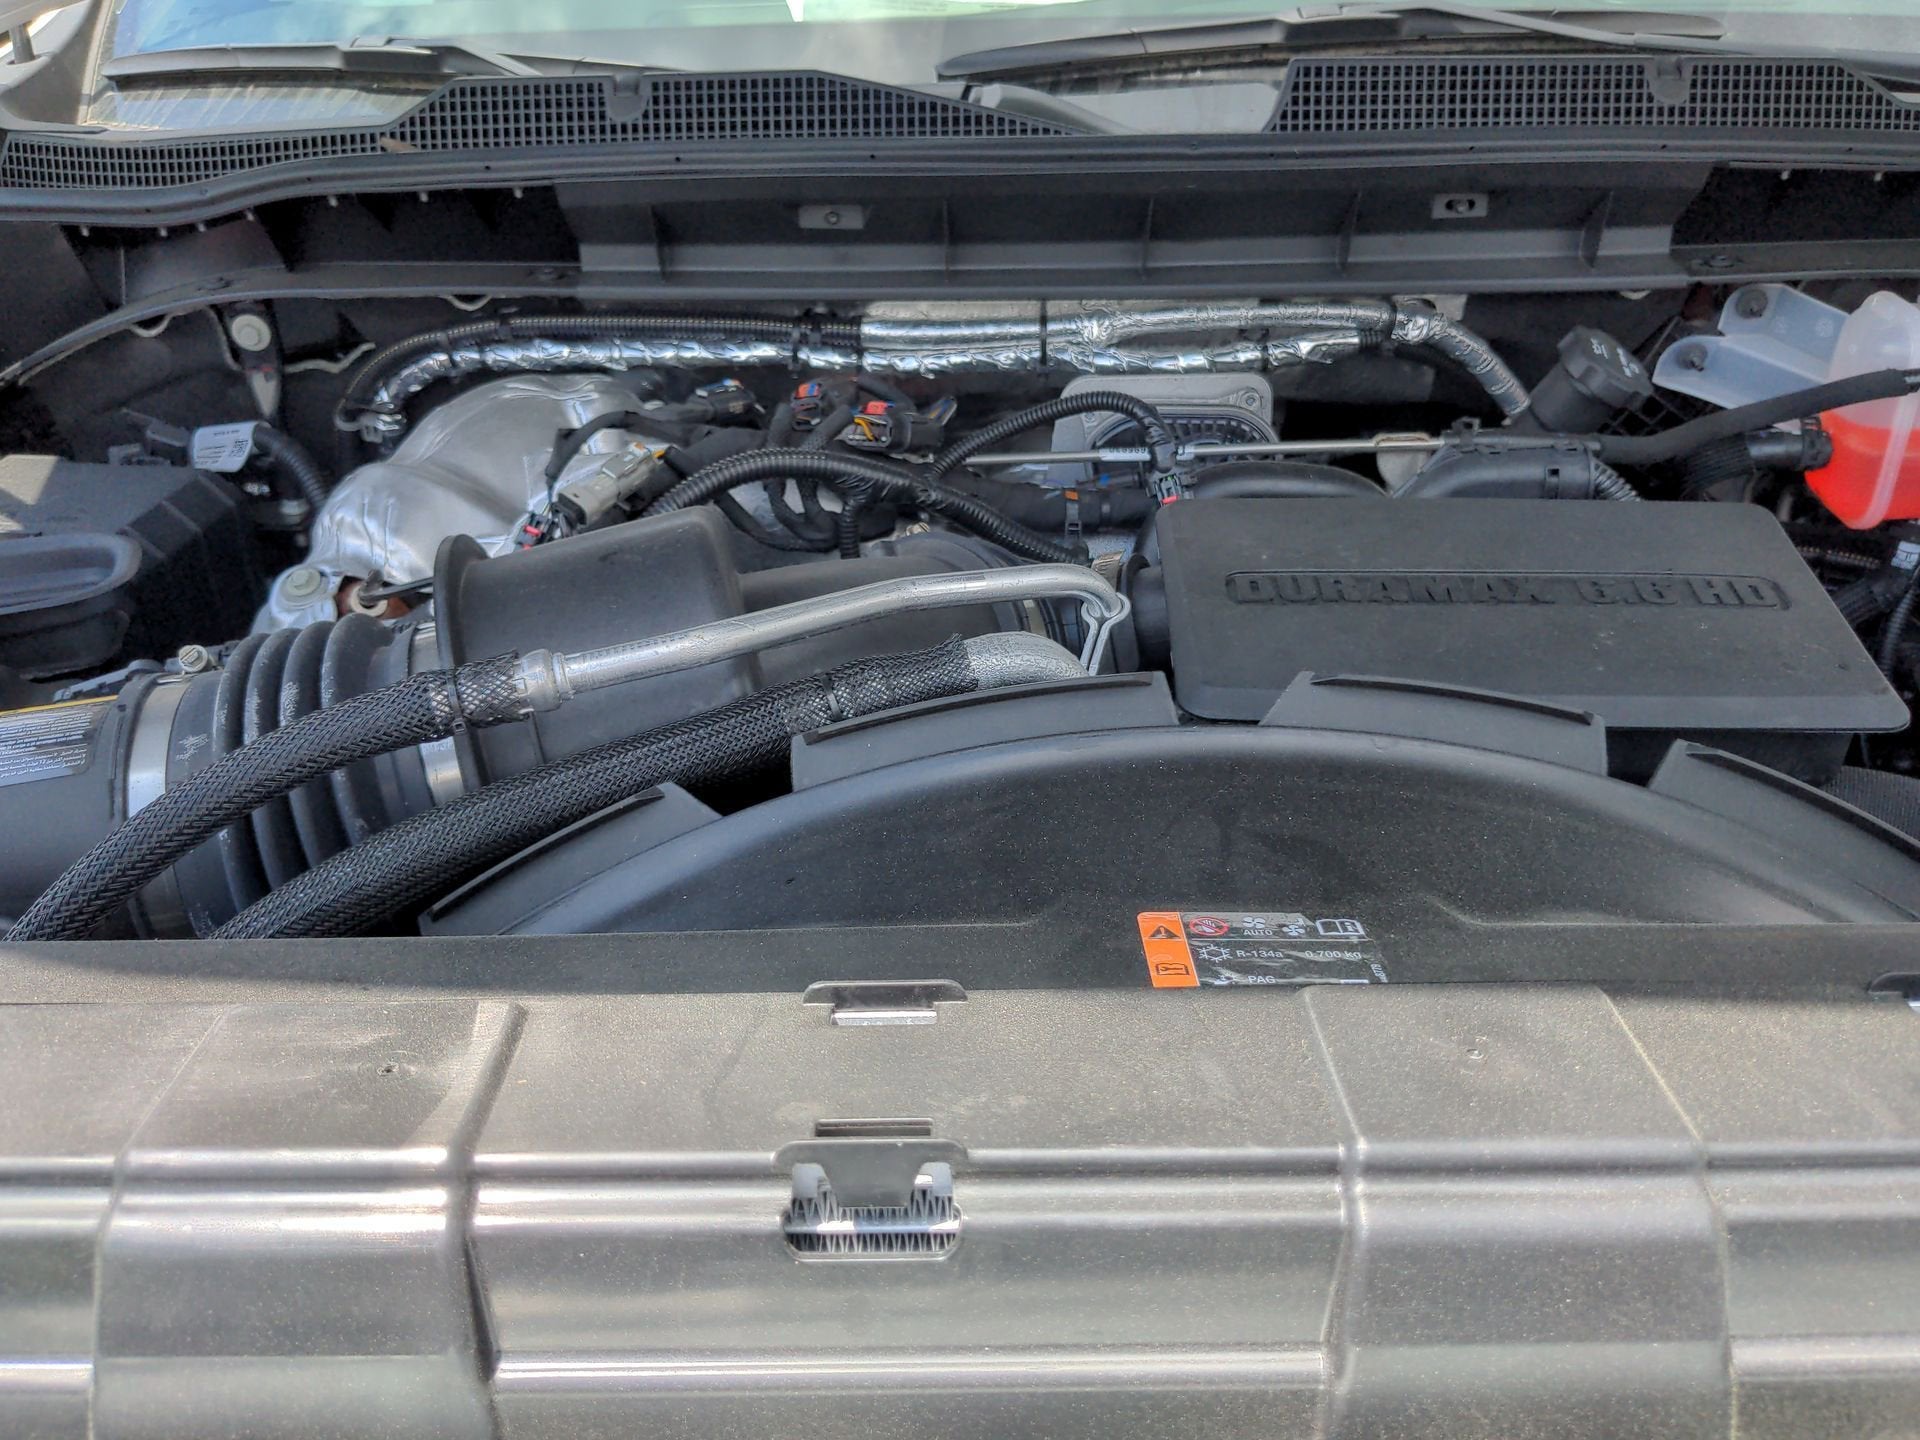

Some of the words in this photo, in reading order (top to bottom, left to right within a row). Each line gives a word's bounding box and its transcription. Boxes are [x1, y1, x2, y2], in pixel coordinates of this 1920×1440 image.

[1234, 575, 1556, 604] DURAMAX
[1576, 577, 1679, 606] 6.6
[1689, 578, 1783, 607] HD
[1242, 929, 1274, 937] AUTO
[1236, 950, 1284, 959] R-134a
[1304, 950, 1342, 959] 0.700
[1344, 950, 1362, 960] kg
[1247, 975, 1278, 984] PAG
